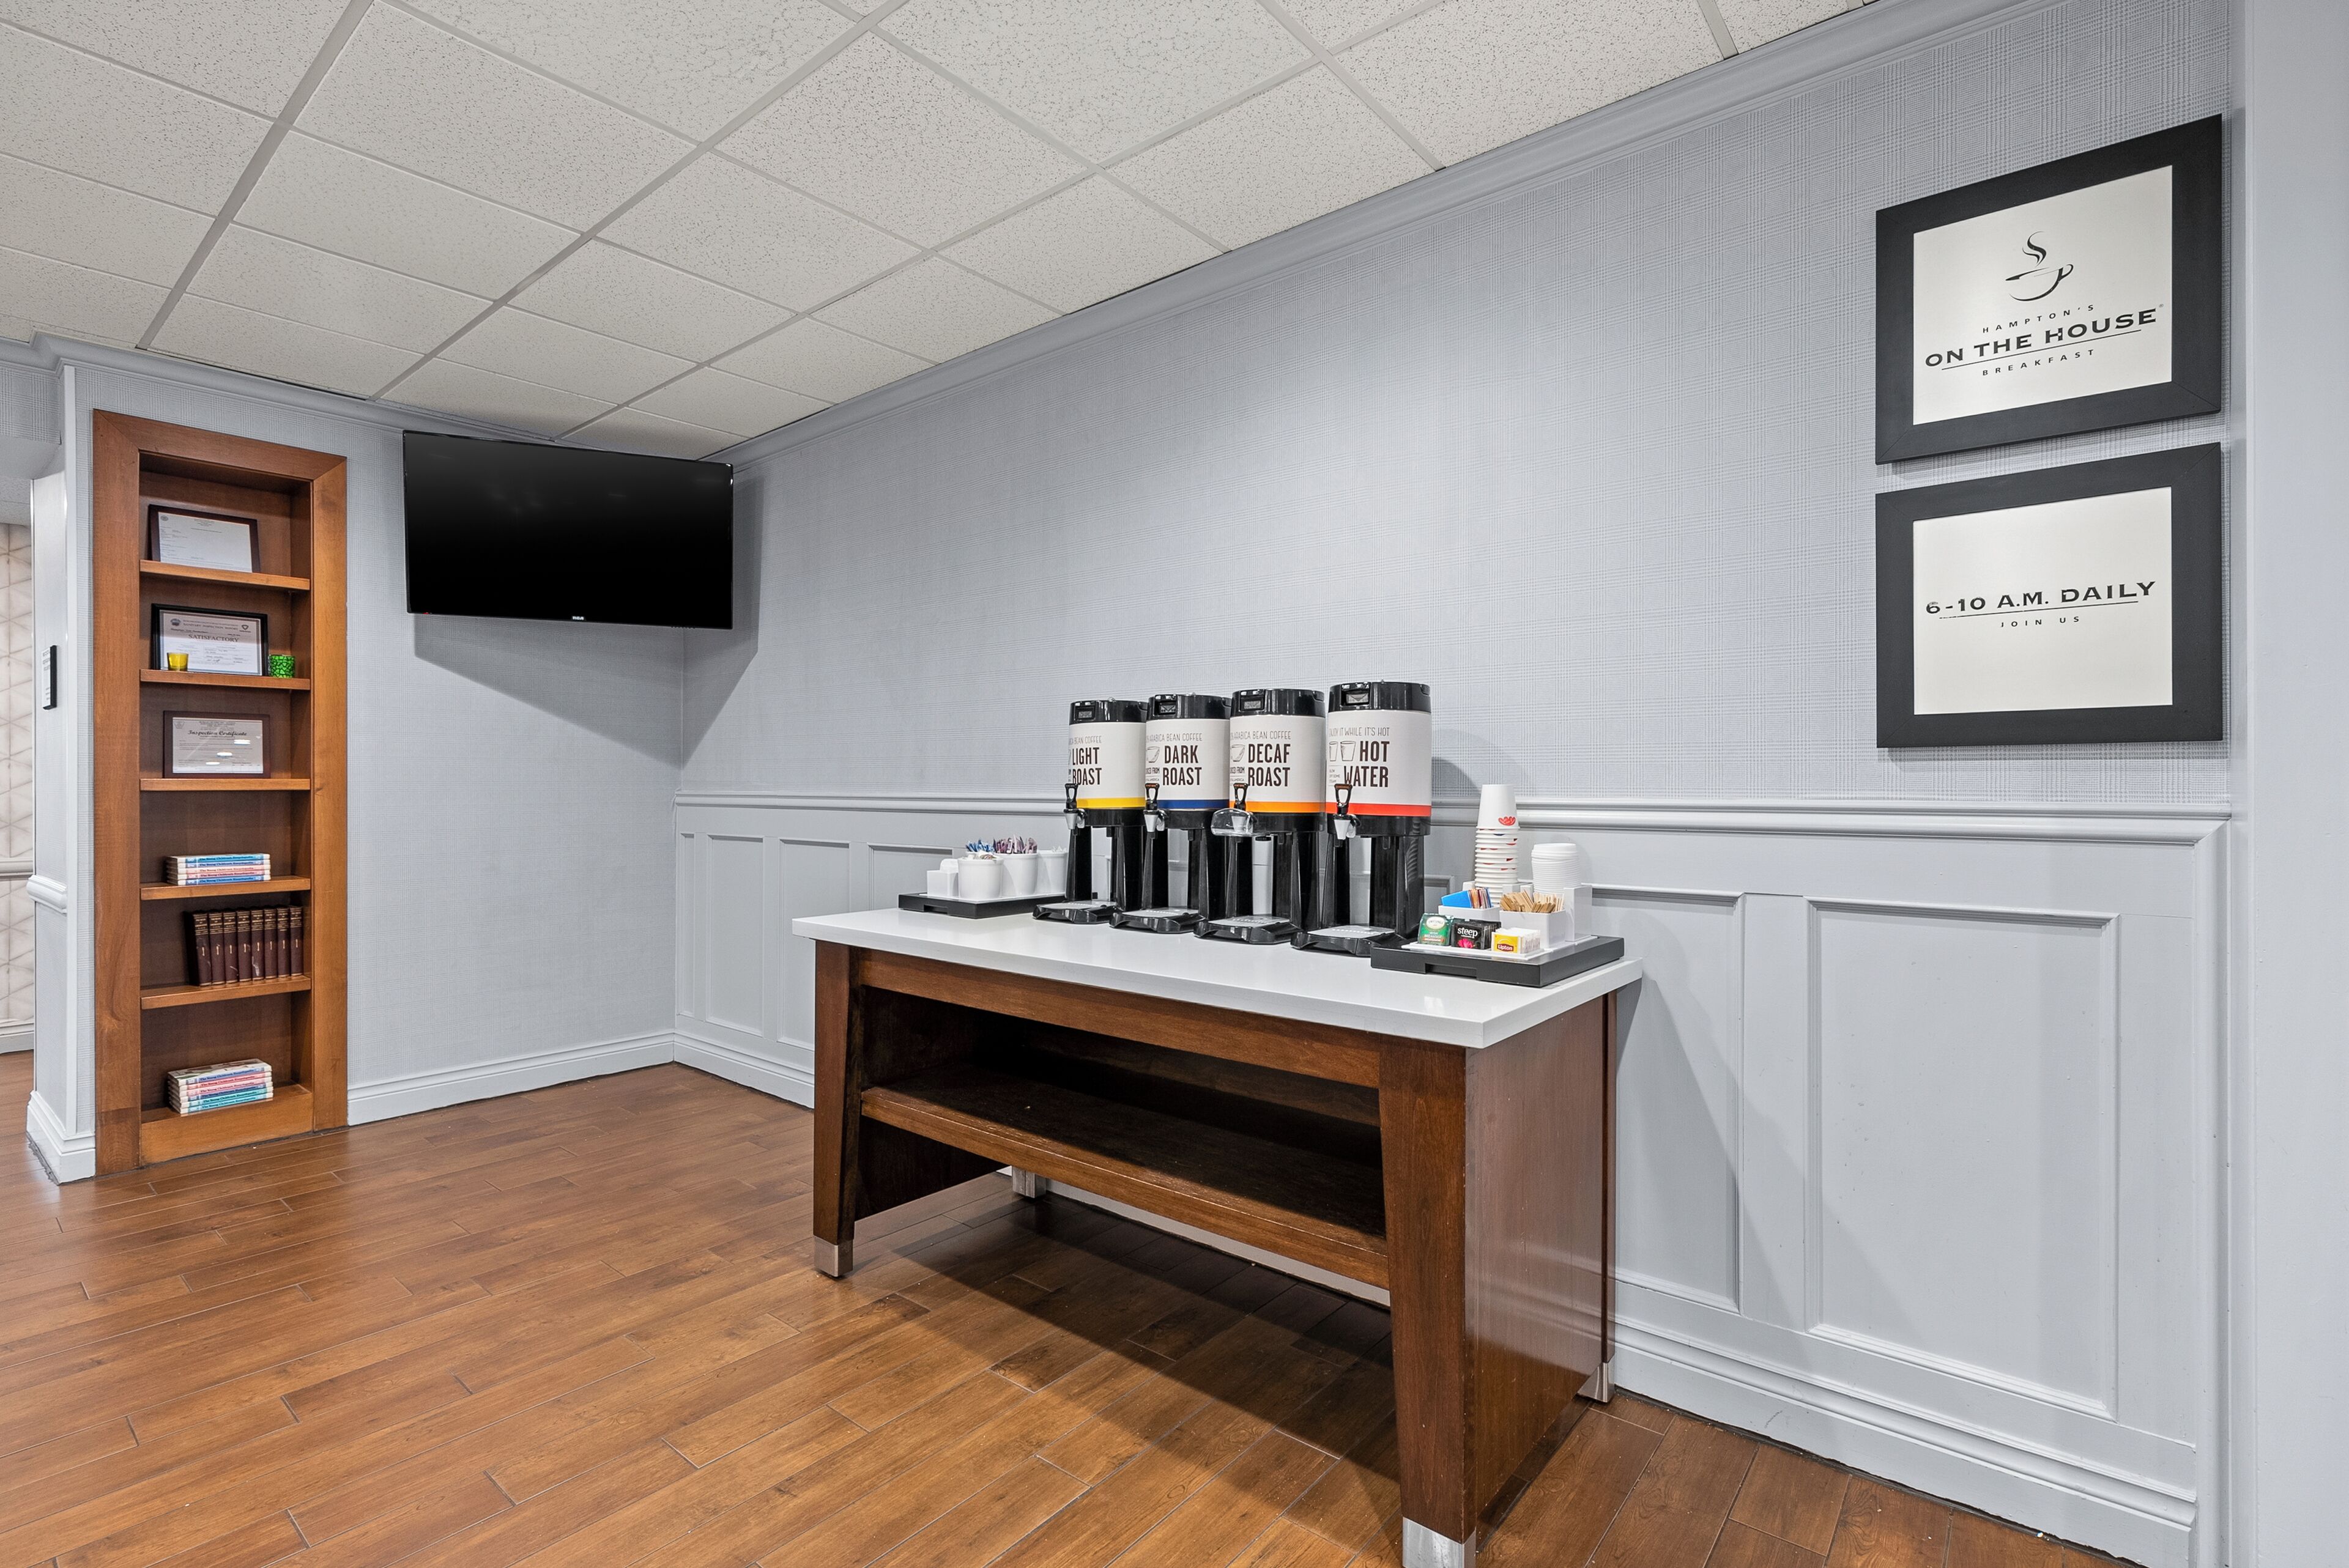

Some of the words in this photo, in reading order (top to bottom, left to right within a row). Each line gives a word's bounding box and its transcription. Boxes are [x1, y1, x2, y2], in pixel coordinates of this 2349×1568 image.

[1983, 305, 2095, 334] HAMPTON'S
[1925, 348, 1964, 367] ON
[1973, 334, 2032, 357] THE
[2045, 308, 2156, 344] HOUSE
[1983, 349, 2094, 376] BREAKFAST
[1926, 597, 1986, 614] 6-10
[1997, 591, 2049, 609] A.M.
[2061, 581, 2156, 604] DAILY
[2001, 618, 2042, 628] JOIN
[1166, 733, 1181, 741] BEAN
[1182, 733, 1203, 741] COFFEE
[1270, 730, 1291, 739] COFFEE
[1365, 727, 1375, 736] IT'S
[1378, 727, 1390, 736] HOT
[1072, 747, 1100, 766] LIGHT
[1164, 745, 1198, 764] DARK
[1248, 744, 1291, 763] DECAF
[1360, 741, 1390, 762] HOT
[1072, 768, 1102, 786] ROAST
[1163, 767, 1202, 786] ROAST
[1248, 767, 1291, 787] ROAST
[1343, 766, 1389, 788] WATER
[1457, 927, 1478, 938] steep
